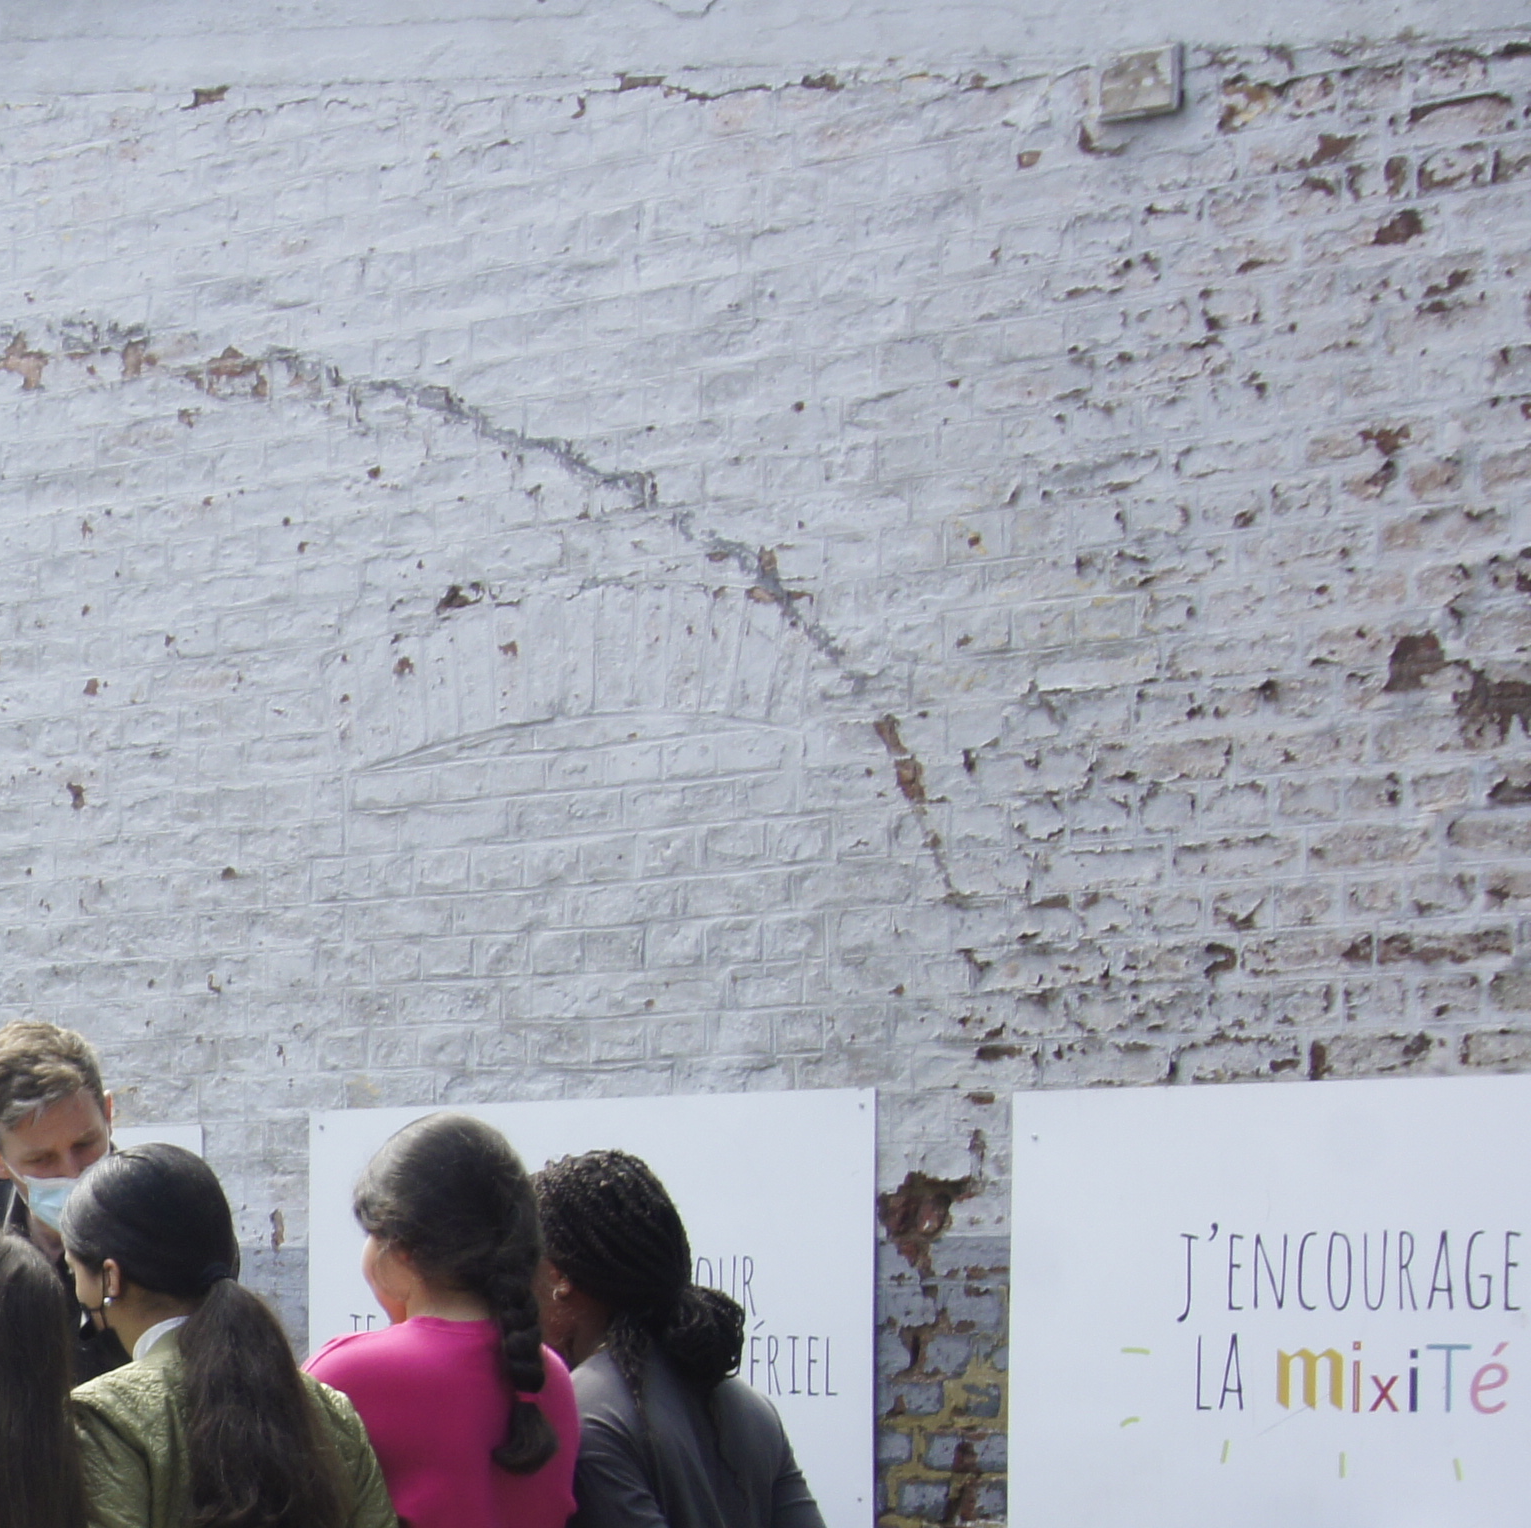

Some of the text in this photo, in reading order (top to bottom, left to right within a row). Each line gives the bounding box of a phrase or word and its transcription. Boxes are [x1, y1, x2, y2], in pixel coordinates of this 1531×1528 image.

[695, 1255, 756, 1318] OUR
[1176, 1222, 1522, 1323] J'ENCOURAGE
[749, 1319, 838, 1397] ÉRIEL
[1195, 1332, 1244, 1411] LA
